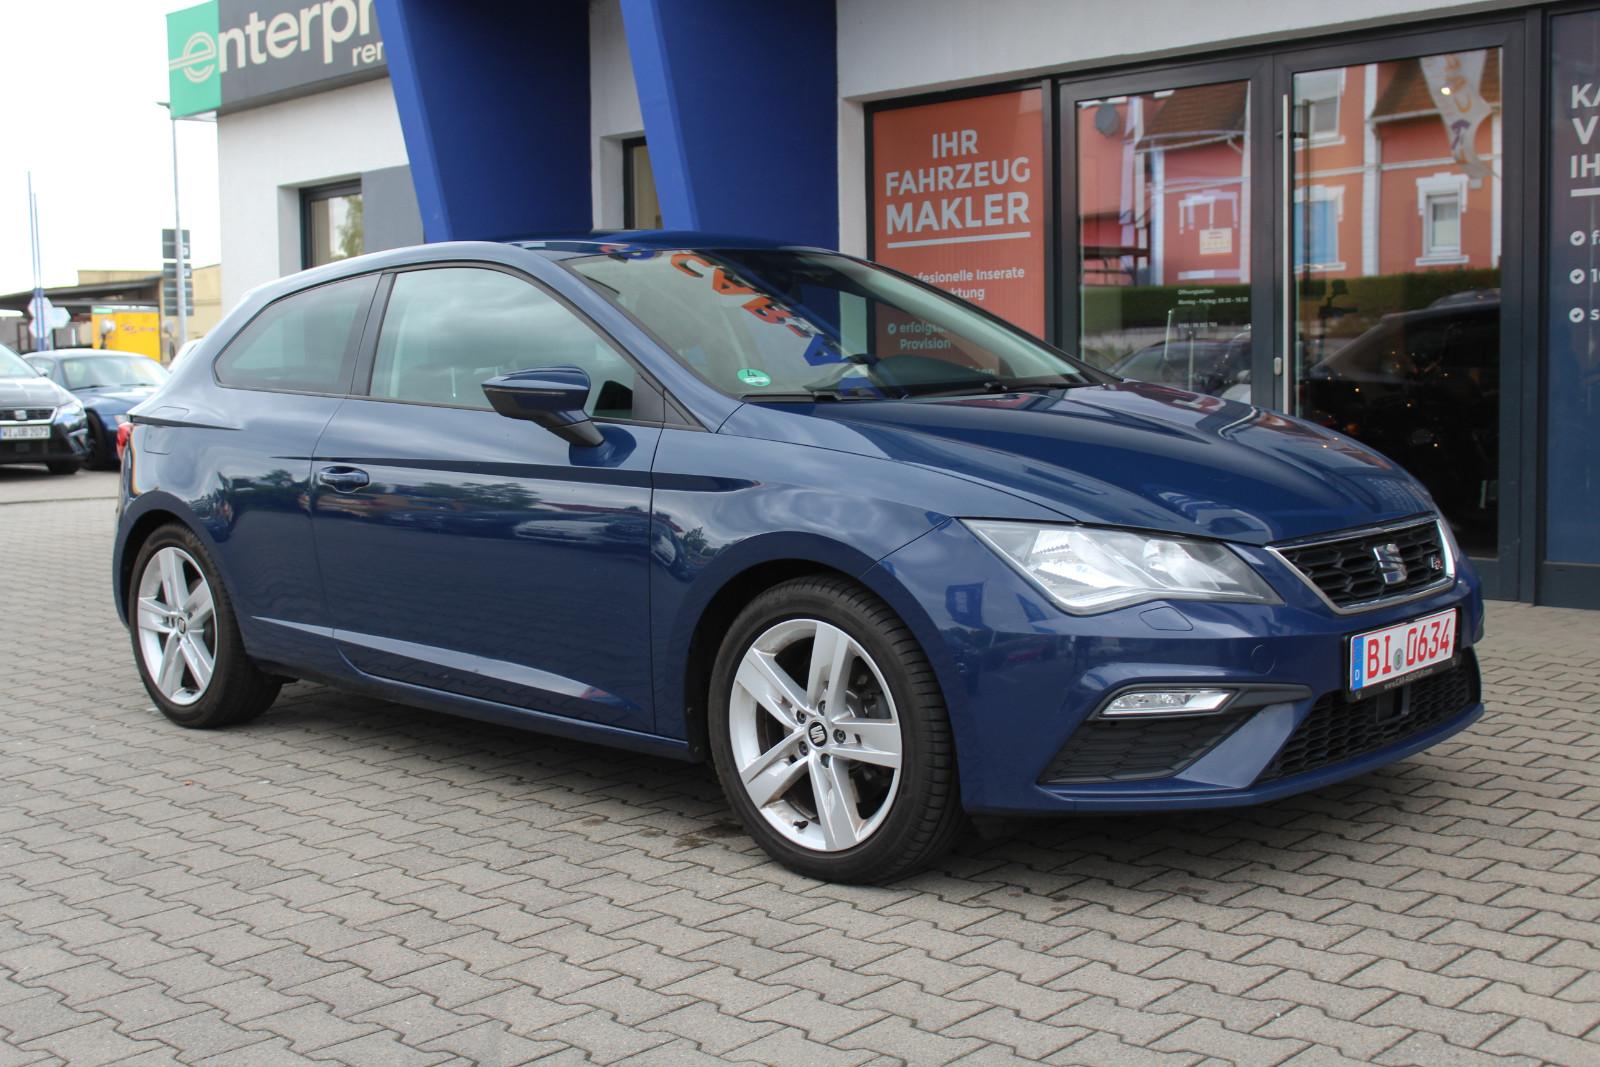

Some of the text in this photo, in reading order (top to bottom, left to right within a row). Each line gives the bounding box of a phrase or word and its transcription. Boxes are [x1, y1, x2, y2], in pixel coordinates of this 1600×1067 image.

[932, 129, 979, 159] IHR
[885, 157, 1031, 197] FAHRZEUG
[886, 191, 1031, 235] MAKLER
[977, 267, 1025, 281] Inserate
[899, 337, 952, 351] Provision
[1367, 635, 1392, 680] BI
[1406, 617, 1451, 667] 0634
